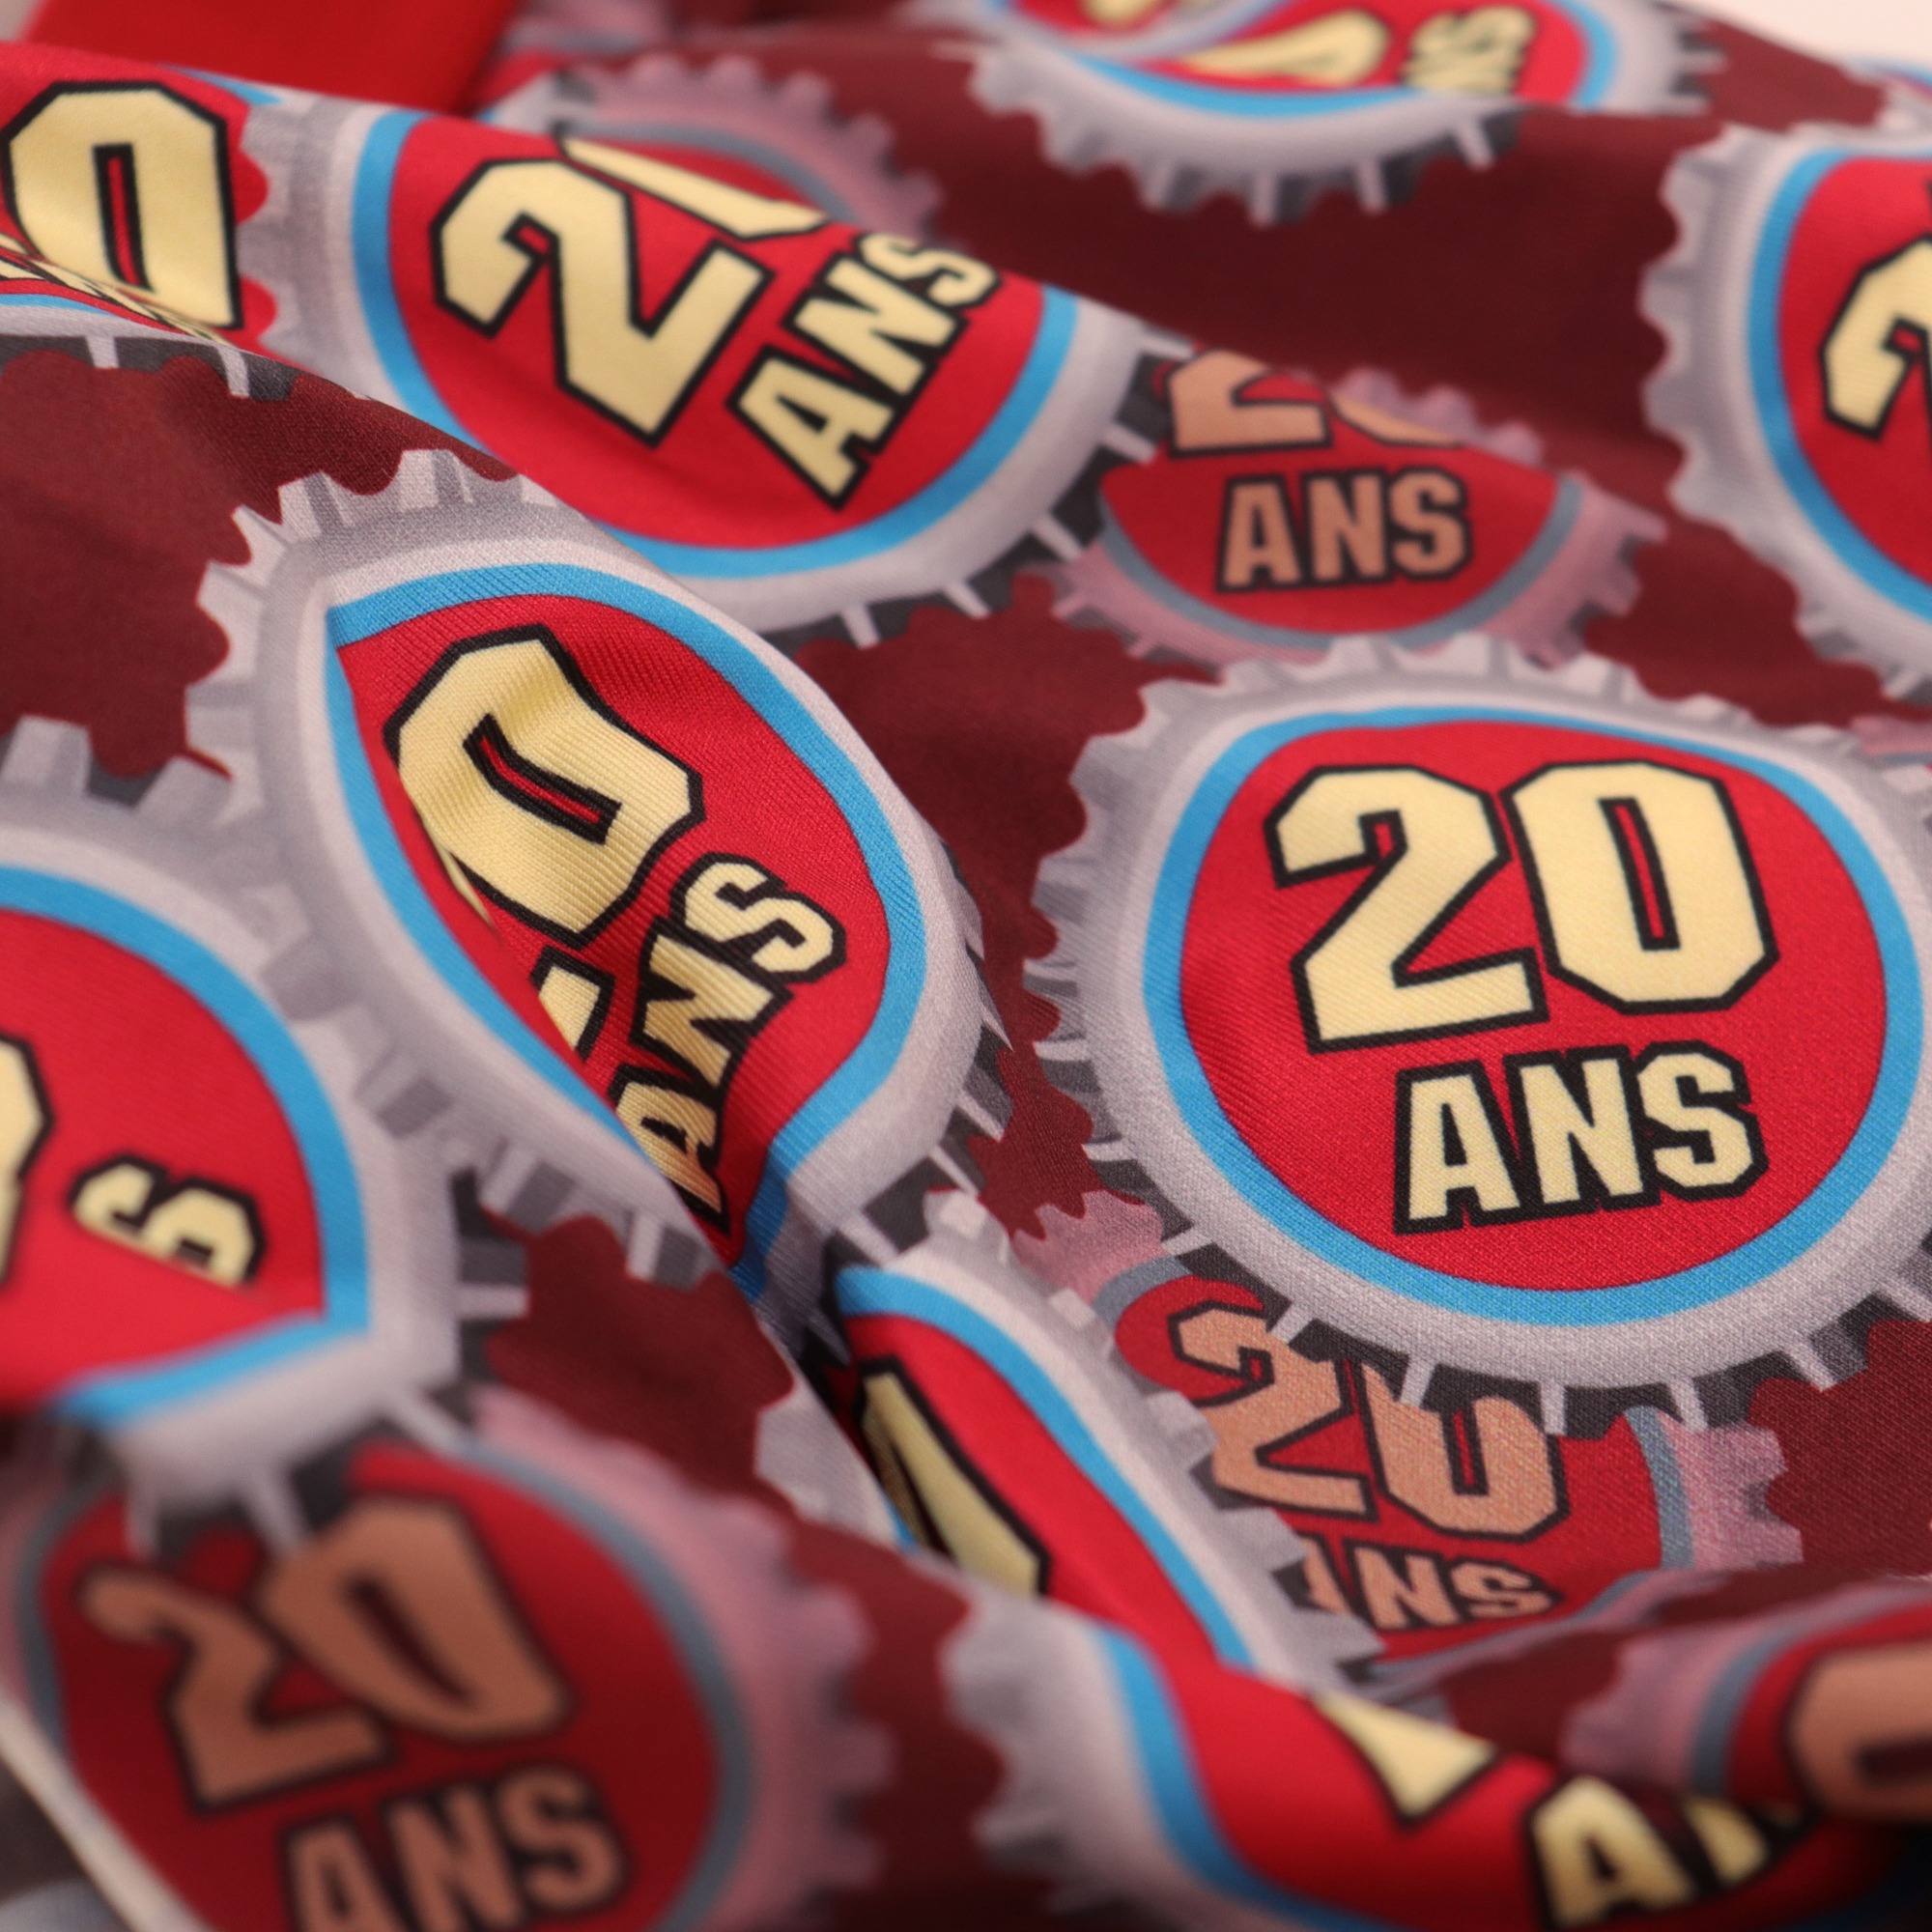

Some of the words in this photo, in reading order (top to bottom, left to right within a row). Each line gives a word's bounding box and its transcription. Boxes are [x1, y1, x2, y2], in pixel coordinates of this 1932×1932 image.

[724, 230, 1003, 512] ANS
[1215, 466, 1474, 594] ANS
[1264, 759, 1779, 1055] 20
[1394, 1039, 1769, 1235] ANS
[75, 1492, 577, 1818] 20
[275, 1760, 635, 1932] ANS
